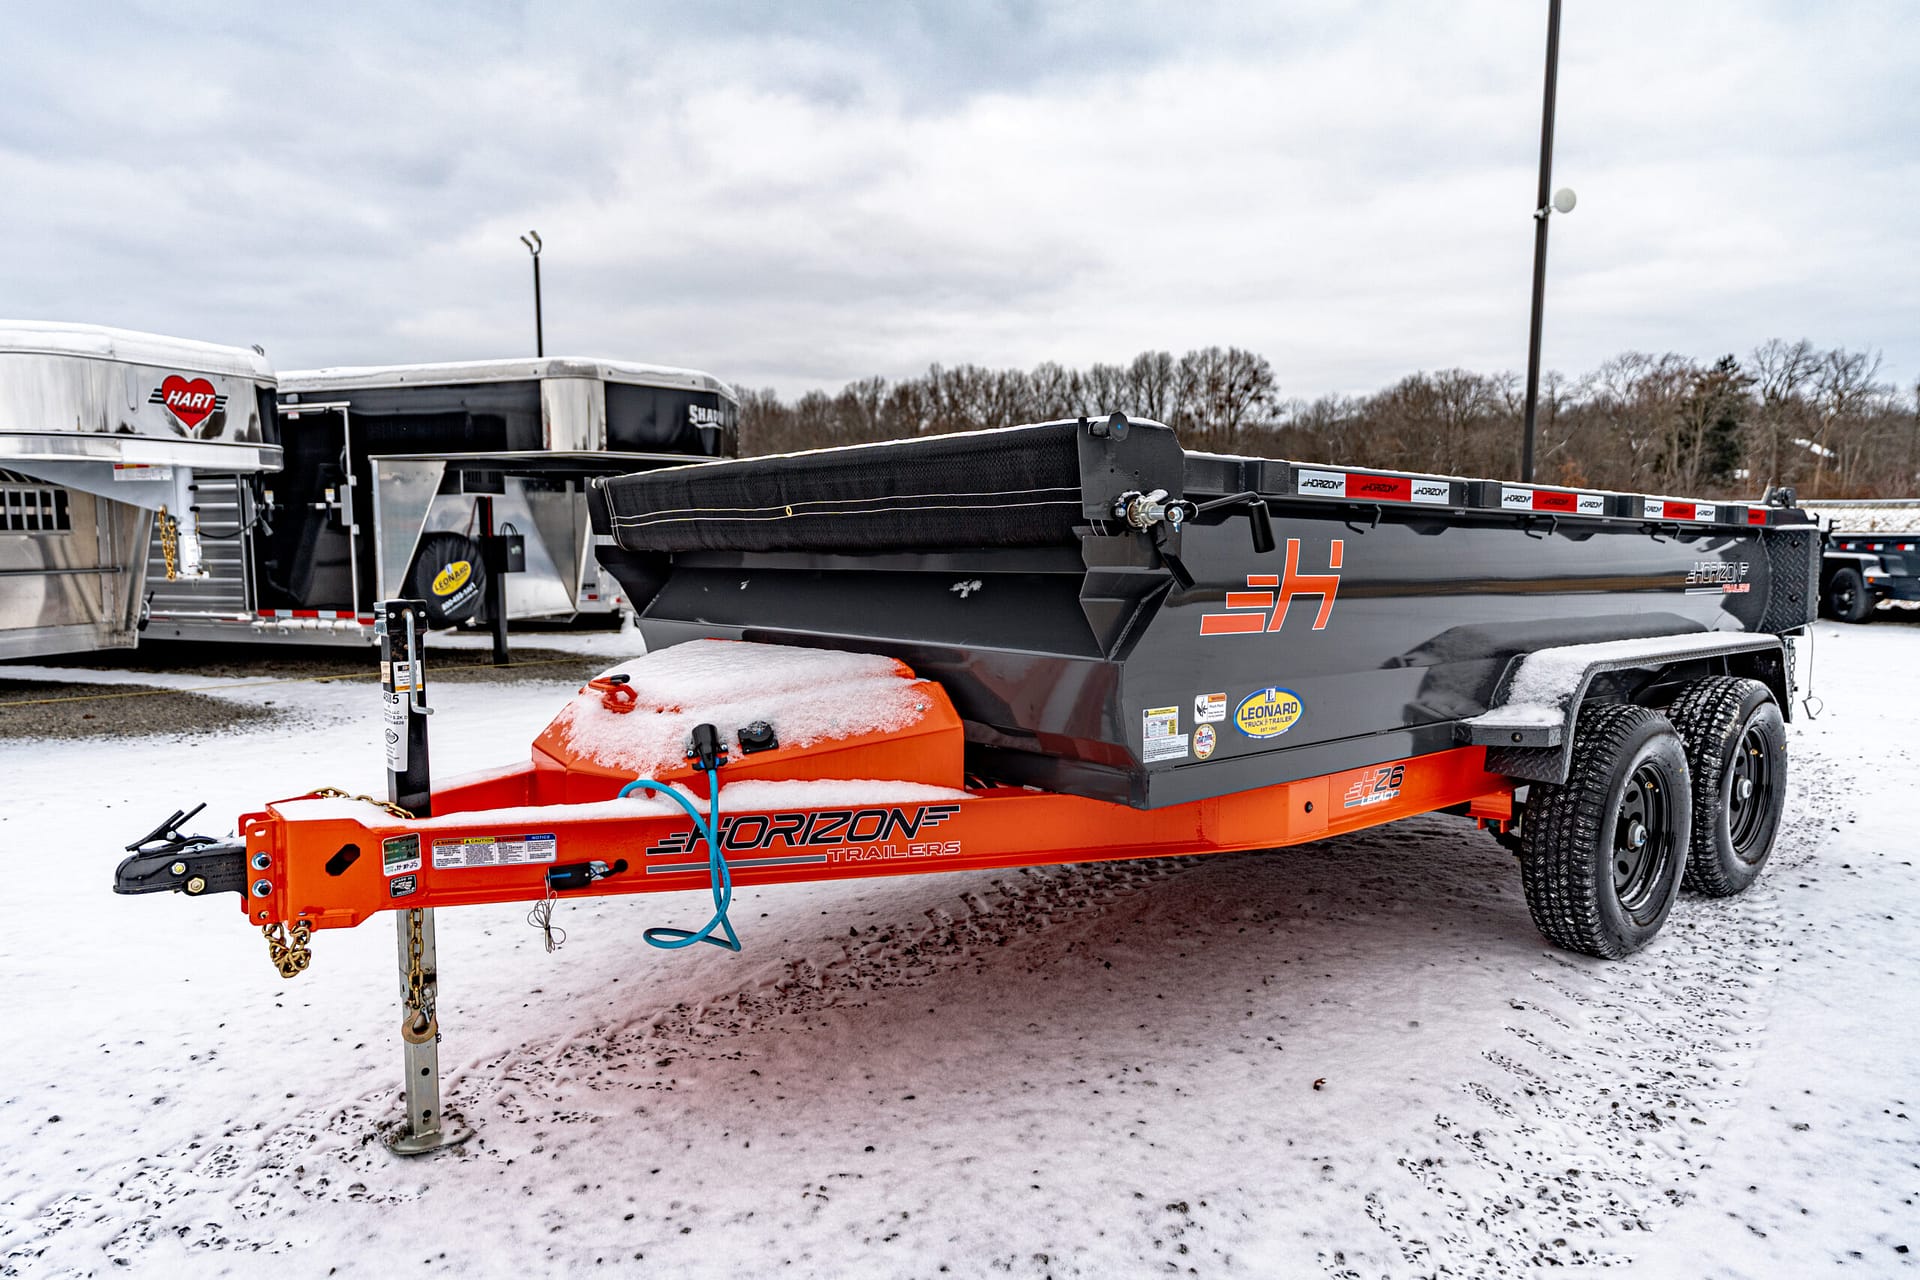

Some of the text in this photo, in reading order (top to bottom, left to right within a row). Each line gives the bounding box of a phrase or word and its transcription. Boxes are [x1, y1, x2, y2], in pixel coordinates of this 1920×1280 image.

[166, 390, 216, 408] HART
[1301, 478, 1344, 489] HORIZON
[1361, 483, 1399, 493] HORIZON
[1413, 487, 1448, 496] HORIZON
[434, 563, 469, 592] LEONARD
[1685, 561, 1749, 583] HORIZON
[1241, 701, 1298, 721] LEONARD
[1244, 720, 1263, 728] TRUCK
[1269, 716, 1292, 725] TRAILER
[646, 804, 960, 854] HORIZON
[827, 841, 961, 863] TRAILERS
